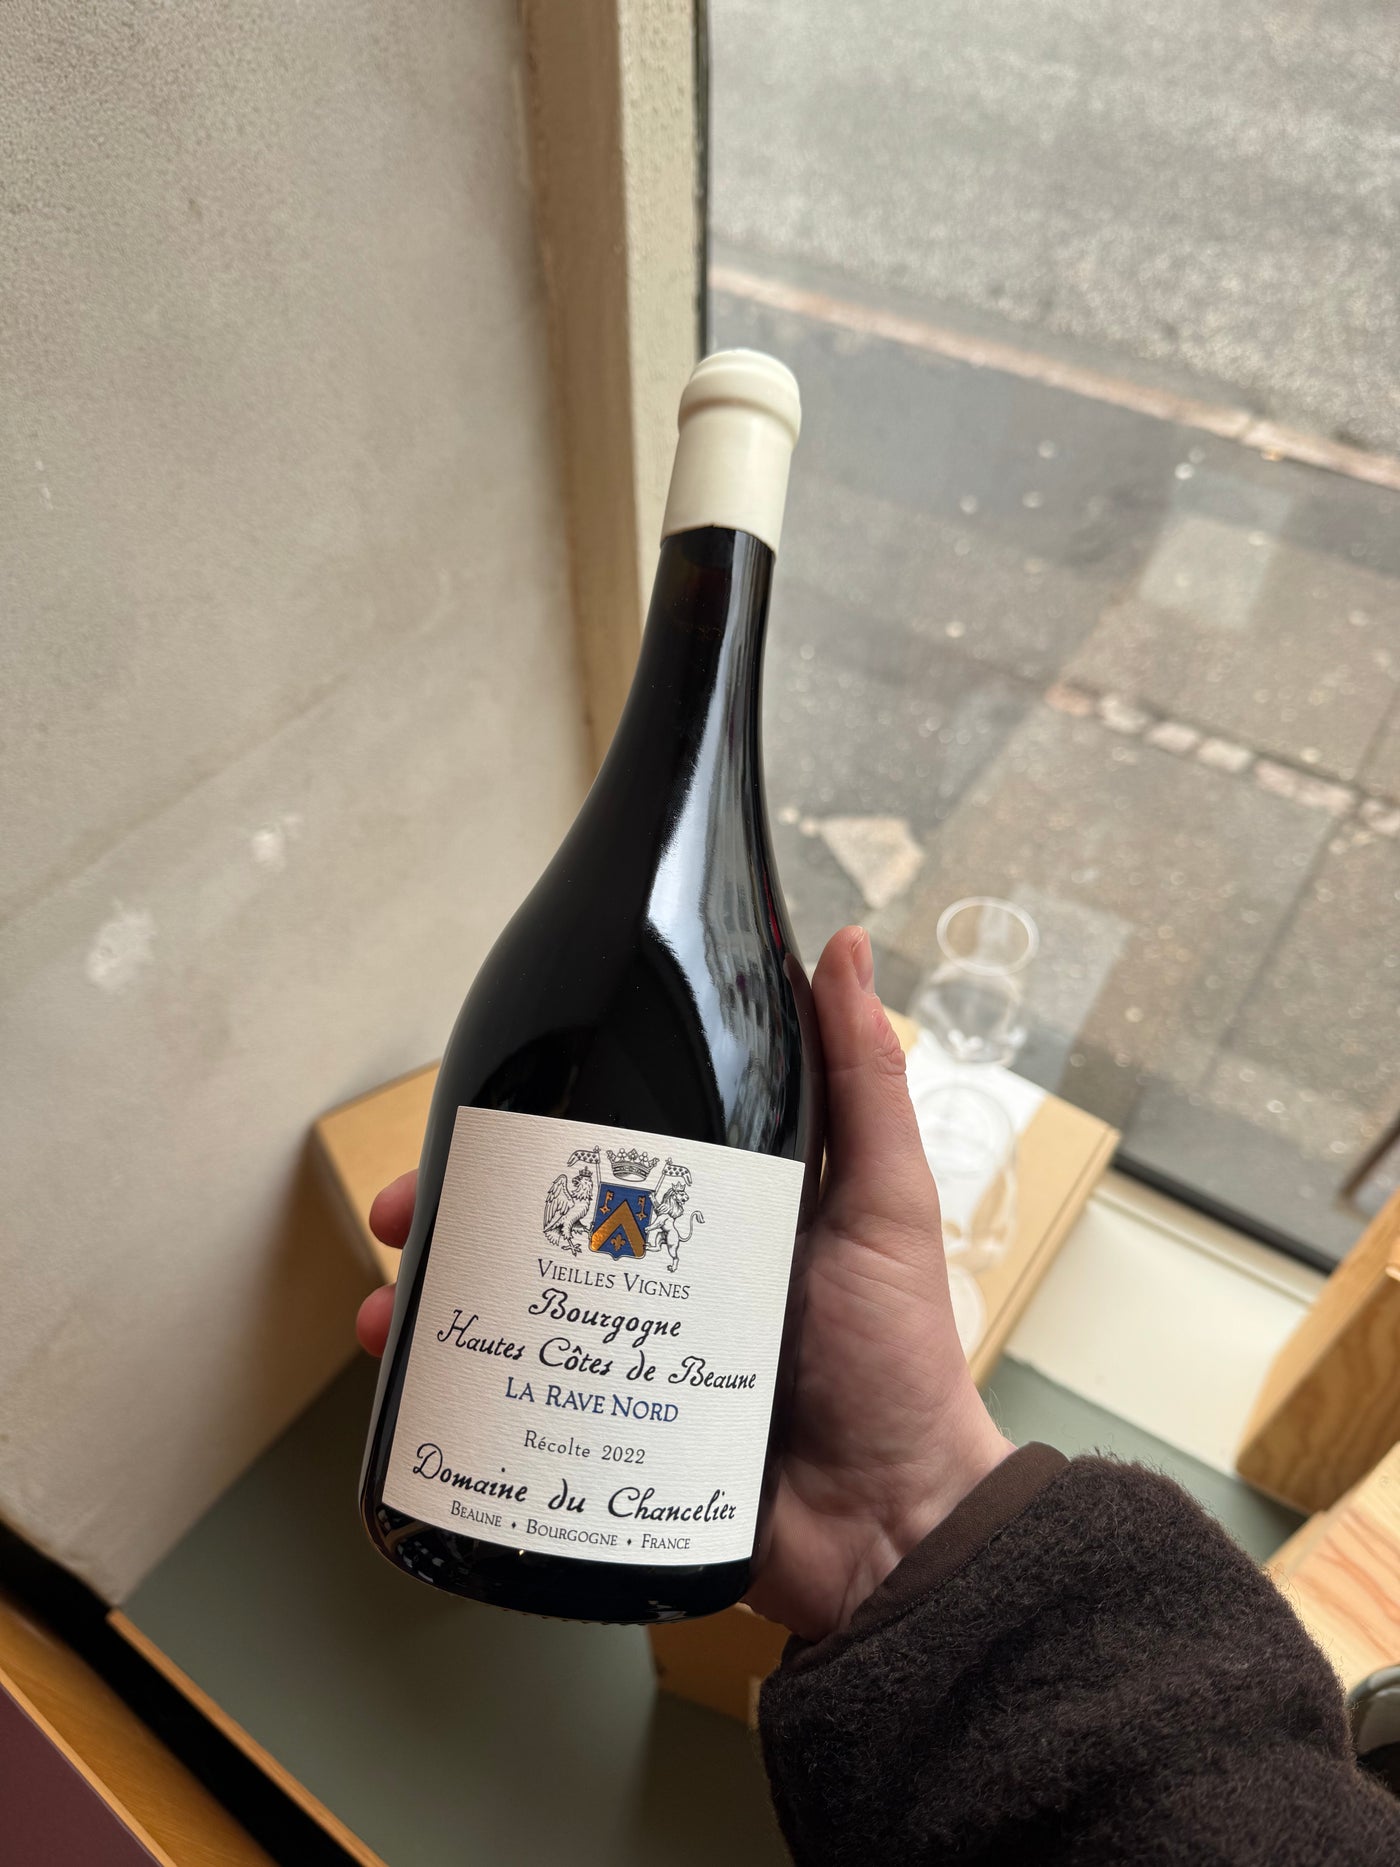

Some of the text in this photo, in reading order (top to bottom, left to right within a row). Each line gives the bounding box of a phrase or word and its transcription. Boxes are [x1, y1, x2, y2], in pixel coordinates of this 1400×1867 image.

[537, 1258, 691, 1300] VIEILLES VIGNES
[527, 1287, 682, 1348] Bourgogne
[436, 1309, 757, 1390] Hautes Côtes de Beaune
[505, 1376, 679, 1423] LA RAVE NORD
[523, 1429, 646, 1465] Récolte 2022
[412, 1442, 737, 1523] Domaine du Chancelier
[450, 1500, 691, 1550] BEAUNE BOURGOGNE FRANCE
